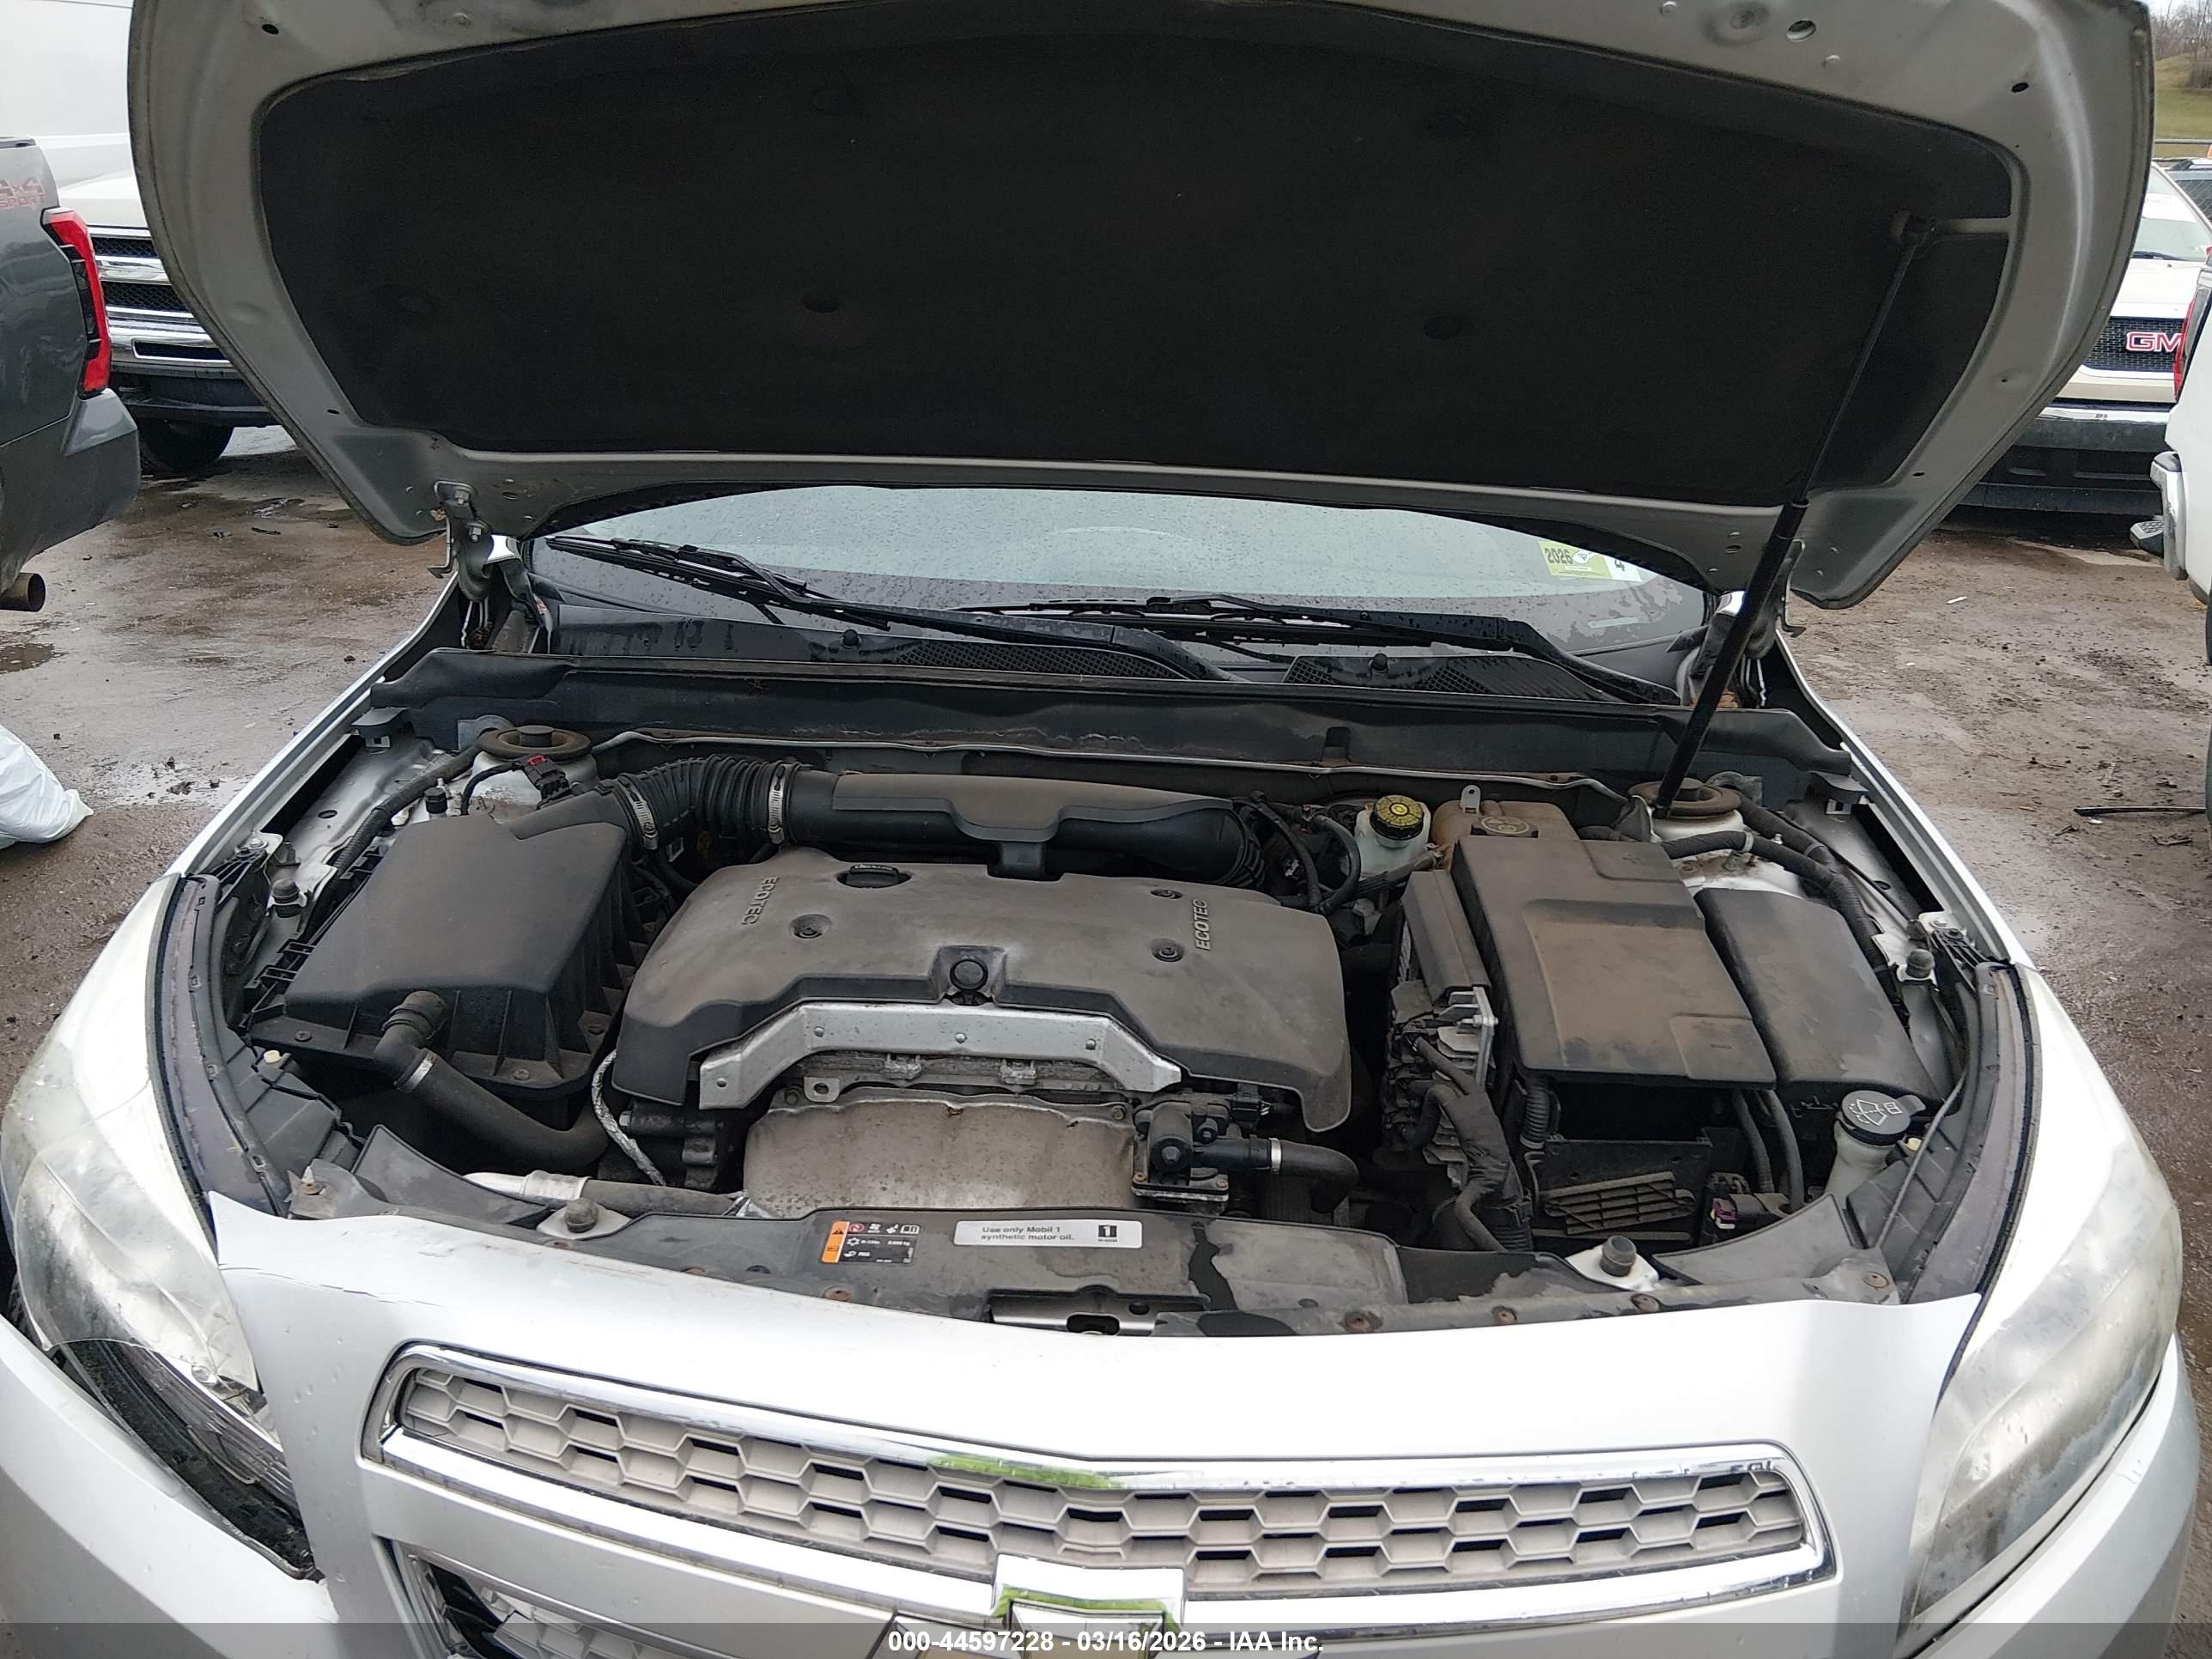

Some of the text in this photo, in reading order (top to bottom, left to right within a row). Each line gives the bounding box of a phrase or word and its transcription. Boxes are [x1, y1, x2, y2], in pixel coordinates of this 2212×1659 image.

[1545, 548, 1573, 564] 2026
[742, 876, 779, 926] ECOTEC
[1192, 898, 1211, 951] ECOTEC
[981, 1233, 1025, 1242] synthetic
[1003, 1226, 1024, 1235] only
